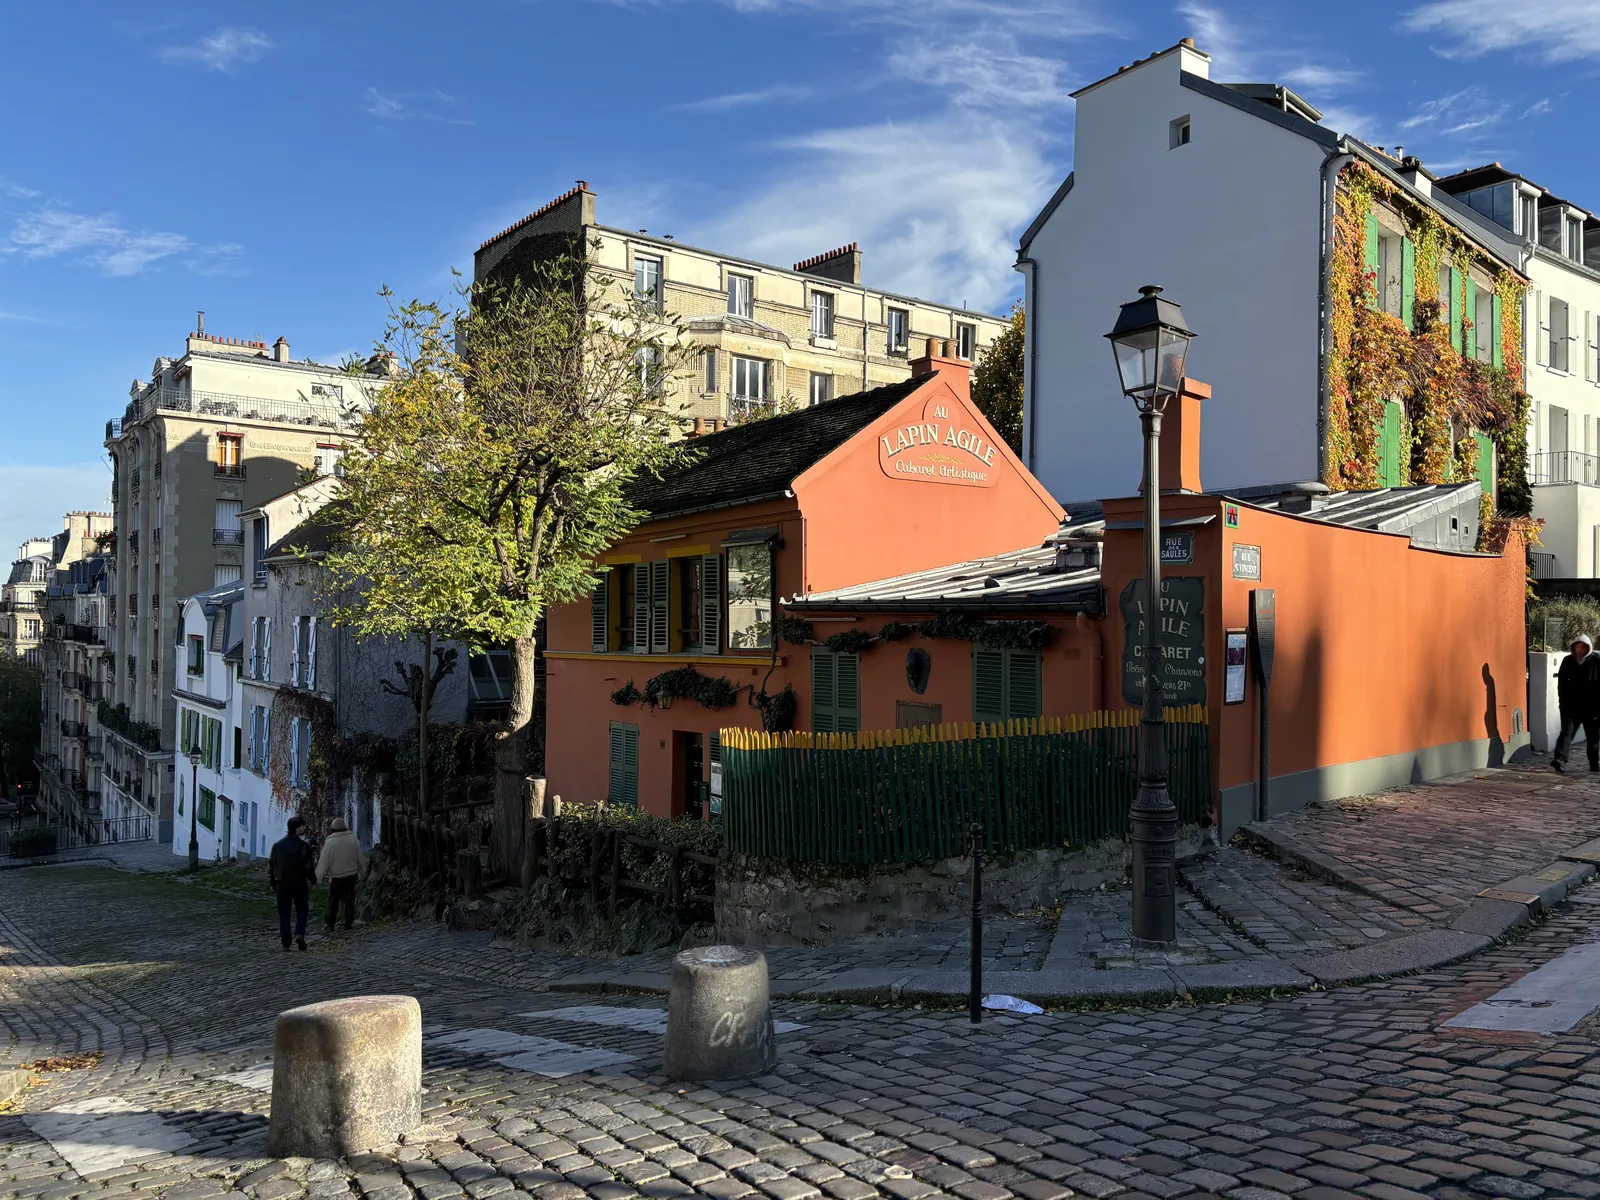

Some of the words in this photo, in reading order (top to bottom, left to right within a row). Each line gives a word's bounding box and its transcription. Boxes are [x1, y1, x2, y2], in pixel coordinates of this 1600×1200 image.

[933, 404, 949, 419] AU
[882, 424, 939, 458] LAPIN
[942, 425, 997, 467] AGILE
[895, 459, 936, 476] Cabaret
[939, 465, 987, 483] Artistique
[1165, 537, 1183, 546] RUE
[1161, 549, 1187, 559] SAULES
[1136, 597, 1189, 617] LPIN
[1137, 617, 1191, 638] AILE
[1134, 645, 1192, 660] CARET
[1164, 663, 1203, 677] Chansons
